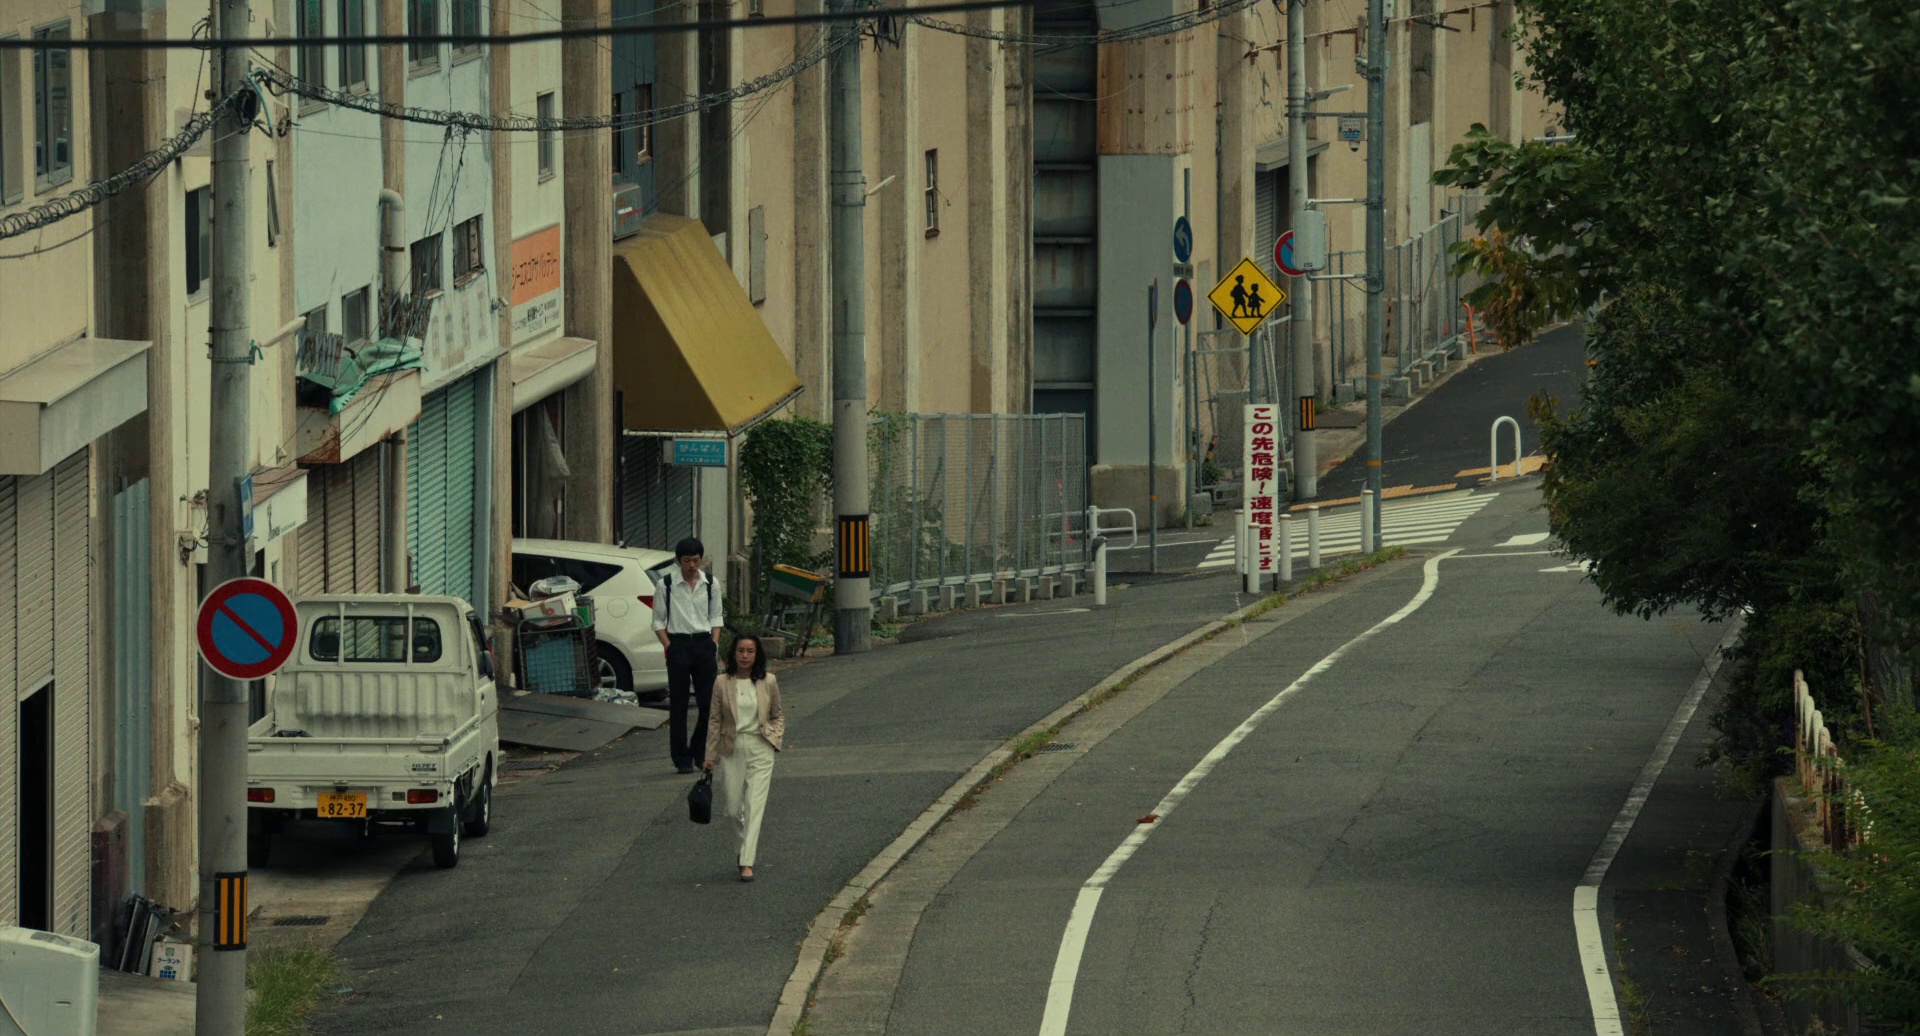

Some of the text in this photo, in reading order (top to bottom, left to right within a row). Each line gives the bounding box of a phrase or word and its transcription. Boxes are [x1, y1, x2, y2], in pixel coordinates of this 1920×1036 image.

[328, 802, 364, 816] 82-37
[157, 957, 181, 965] クーラント
